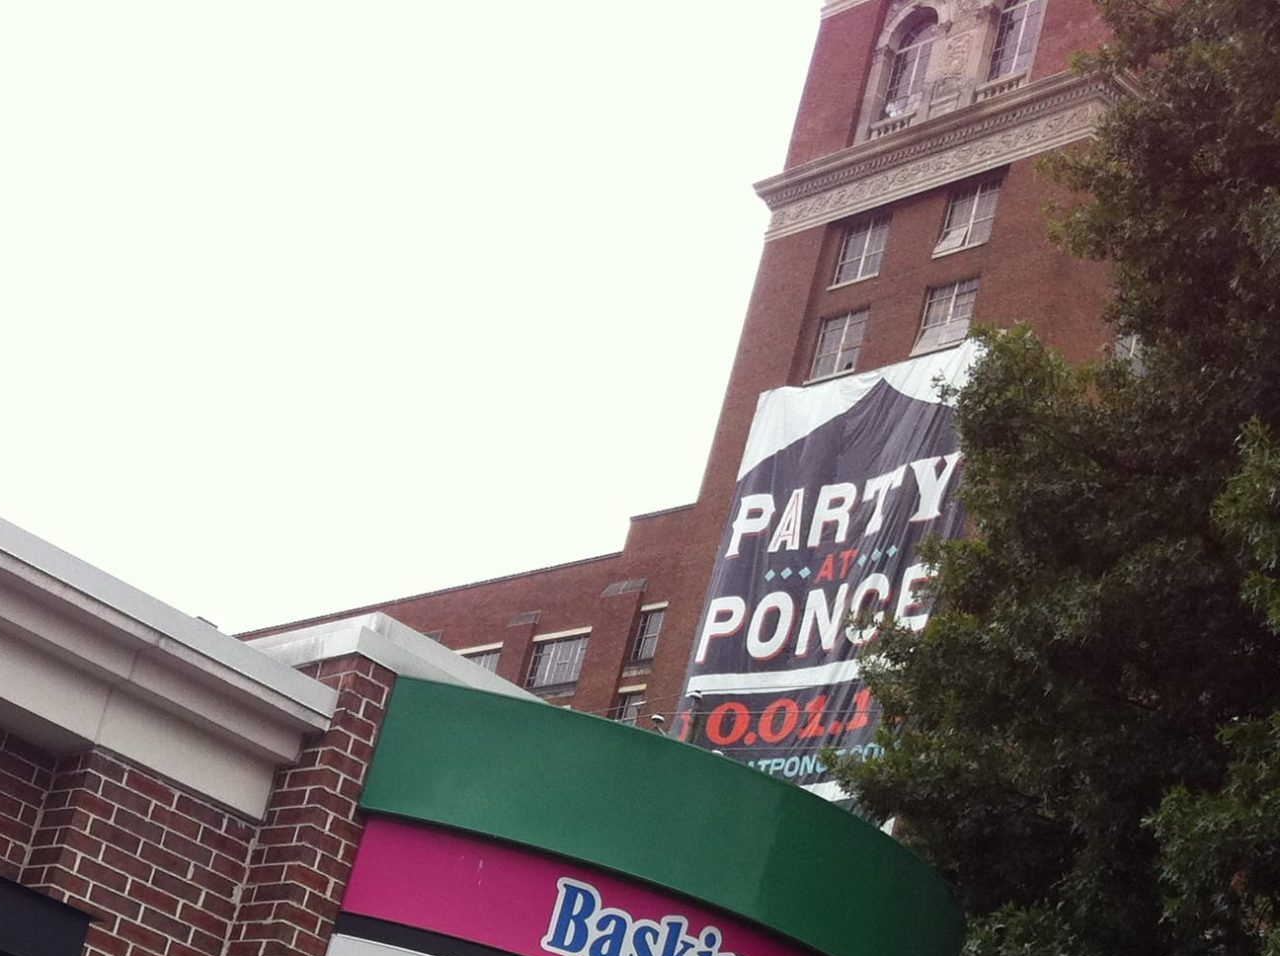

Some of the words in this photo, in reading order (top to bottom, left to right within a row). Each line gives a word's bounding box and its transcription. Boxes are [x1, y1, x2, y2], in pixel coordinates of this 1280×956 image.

[725, 451, 963, 560] PARTY
[695, 563, 940, 665] PONCE
[815, 549, 858, 583] AT
